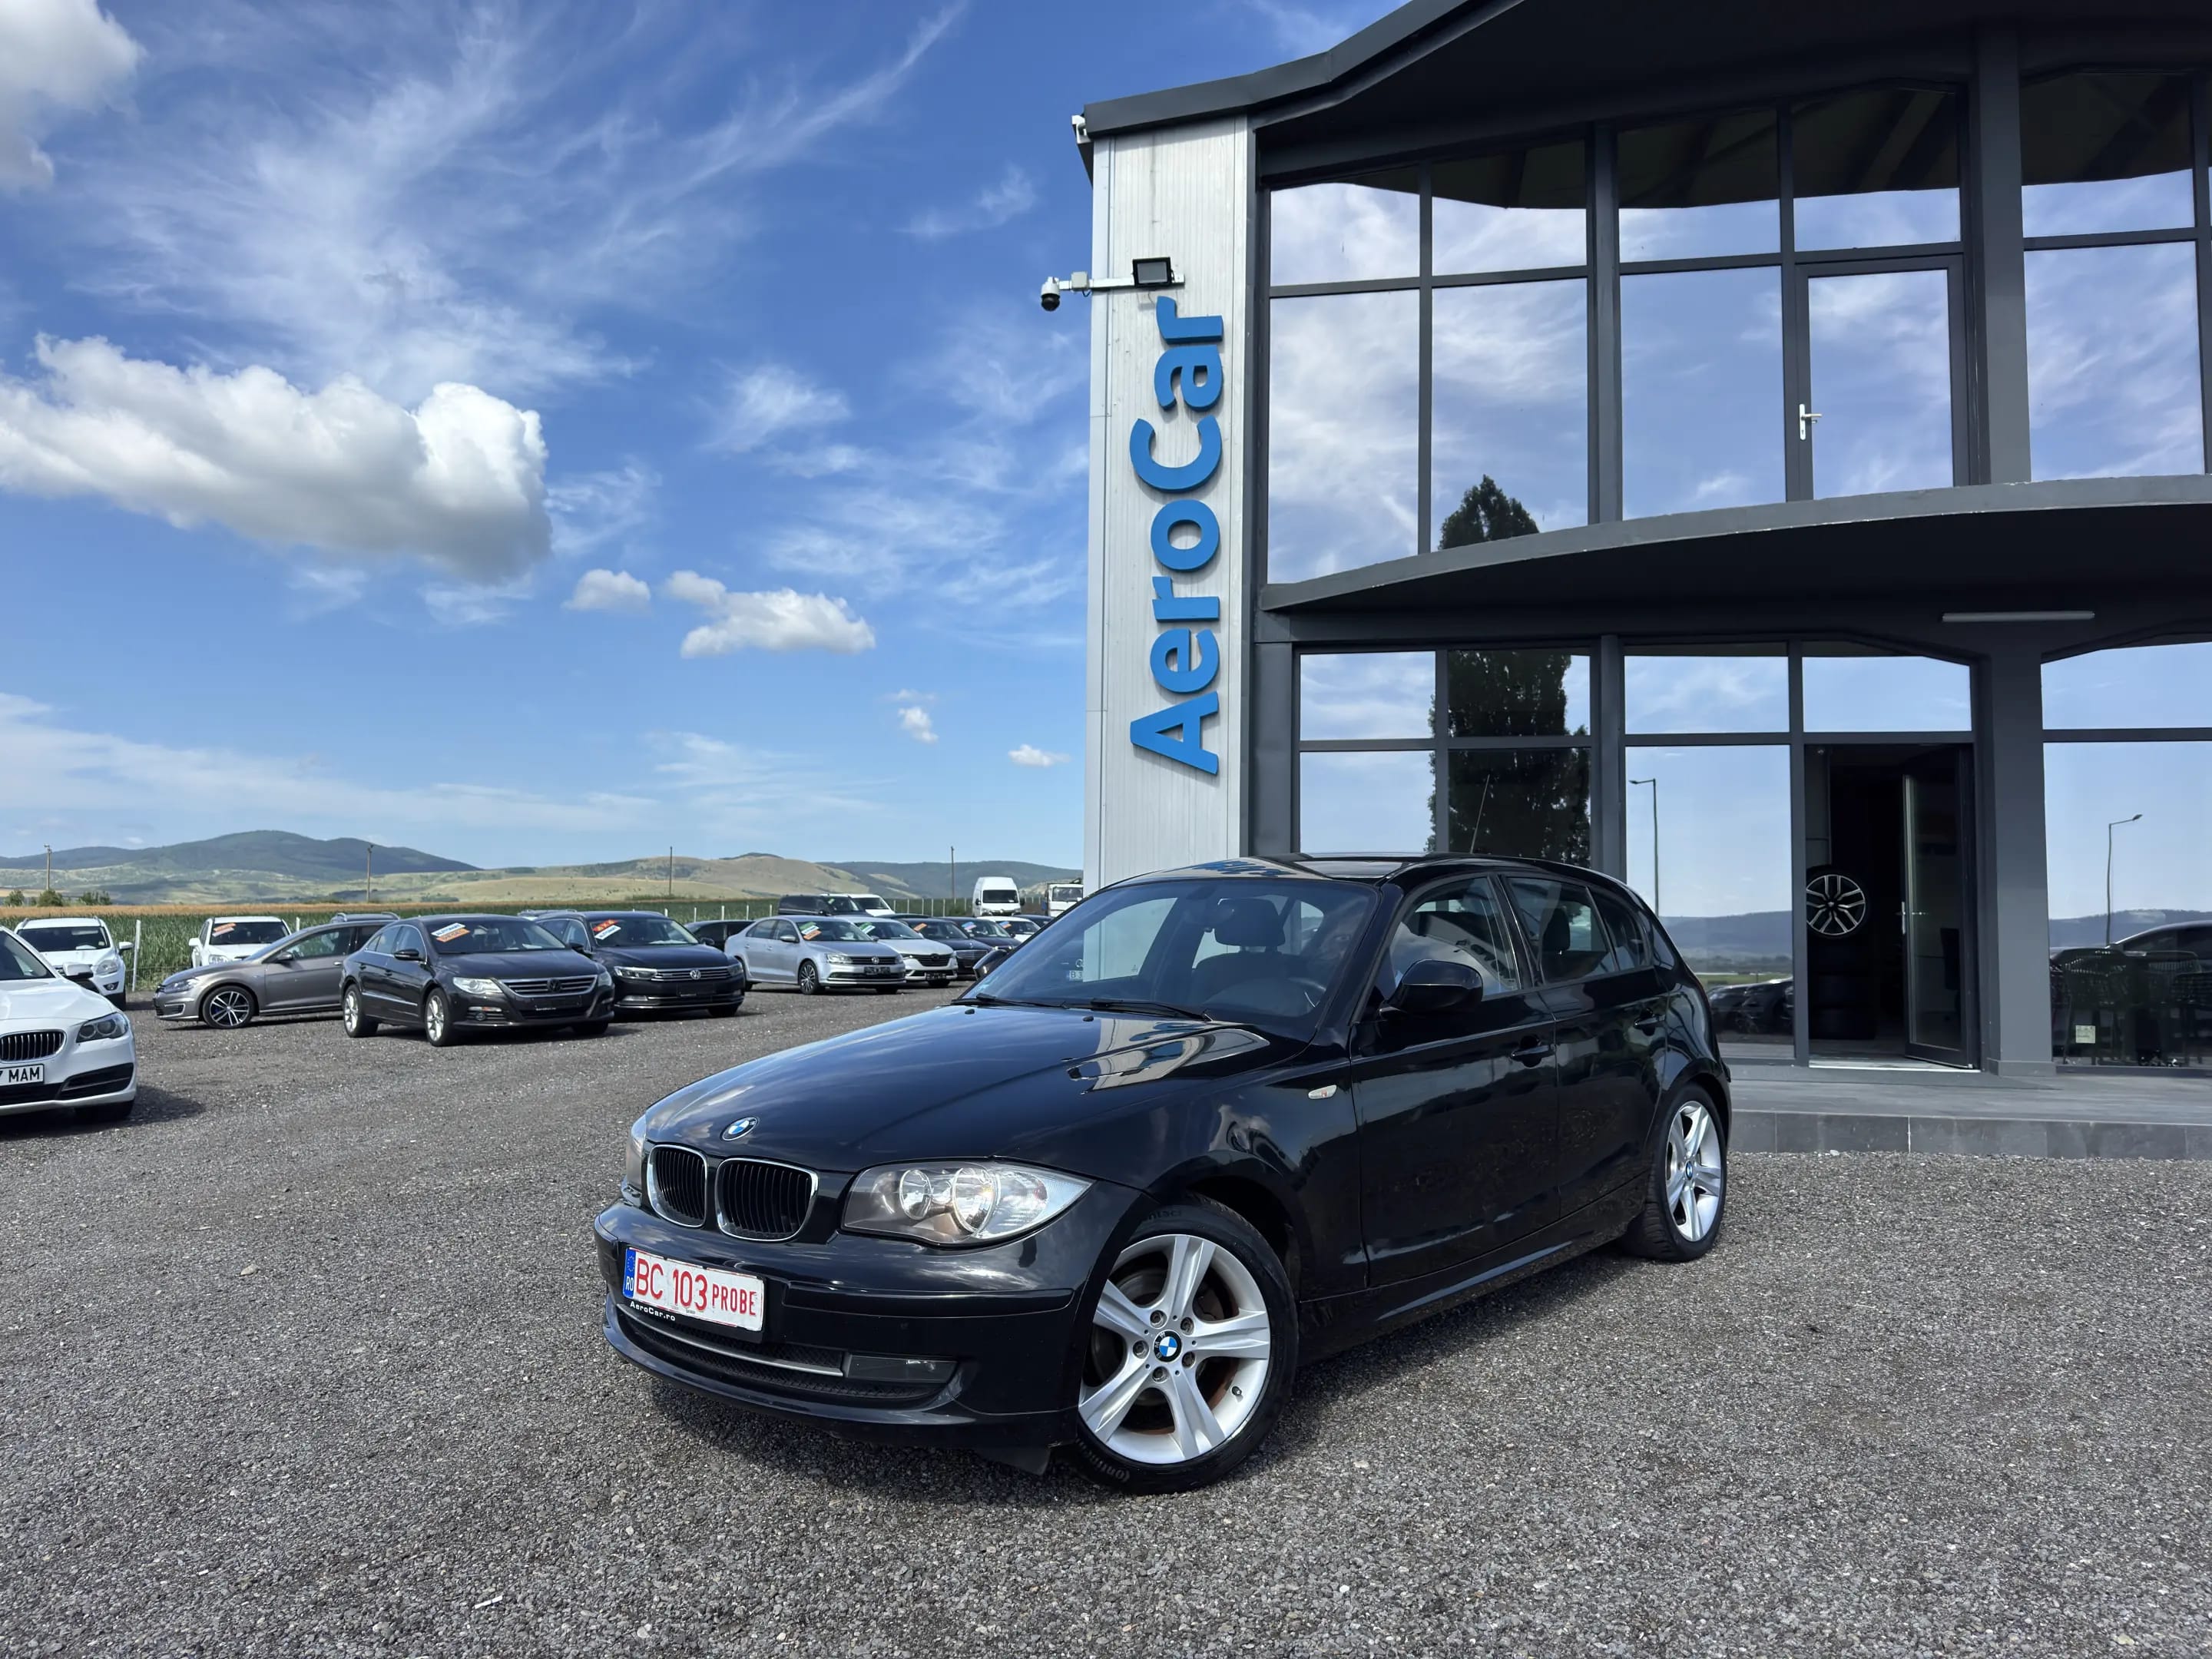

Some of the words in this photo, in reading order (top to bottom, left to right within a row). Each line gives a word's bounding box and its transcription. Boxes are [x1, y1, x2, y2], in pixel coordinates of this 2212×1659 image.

[1130, 295, 1224, 776] AeroCar
[8, 1066, 40, 1083] MAM
[625, 1276, 634, 1292] RO
[635, 1258, 664, 1300] BC
[672, 1269, 708, 1311] 103
[711, 1283, 757, 1316] PROBE
[630, 1300, 676, 1321] AeroCar.ro
